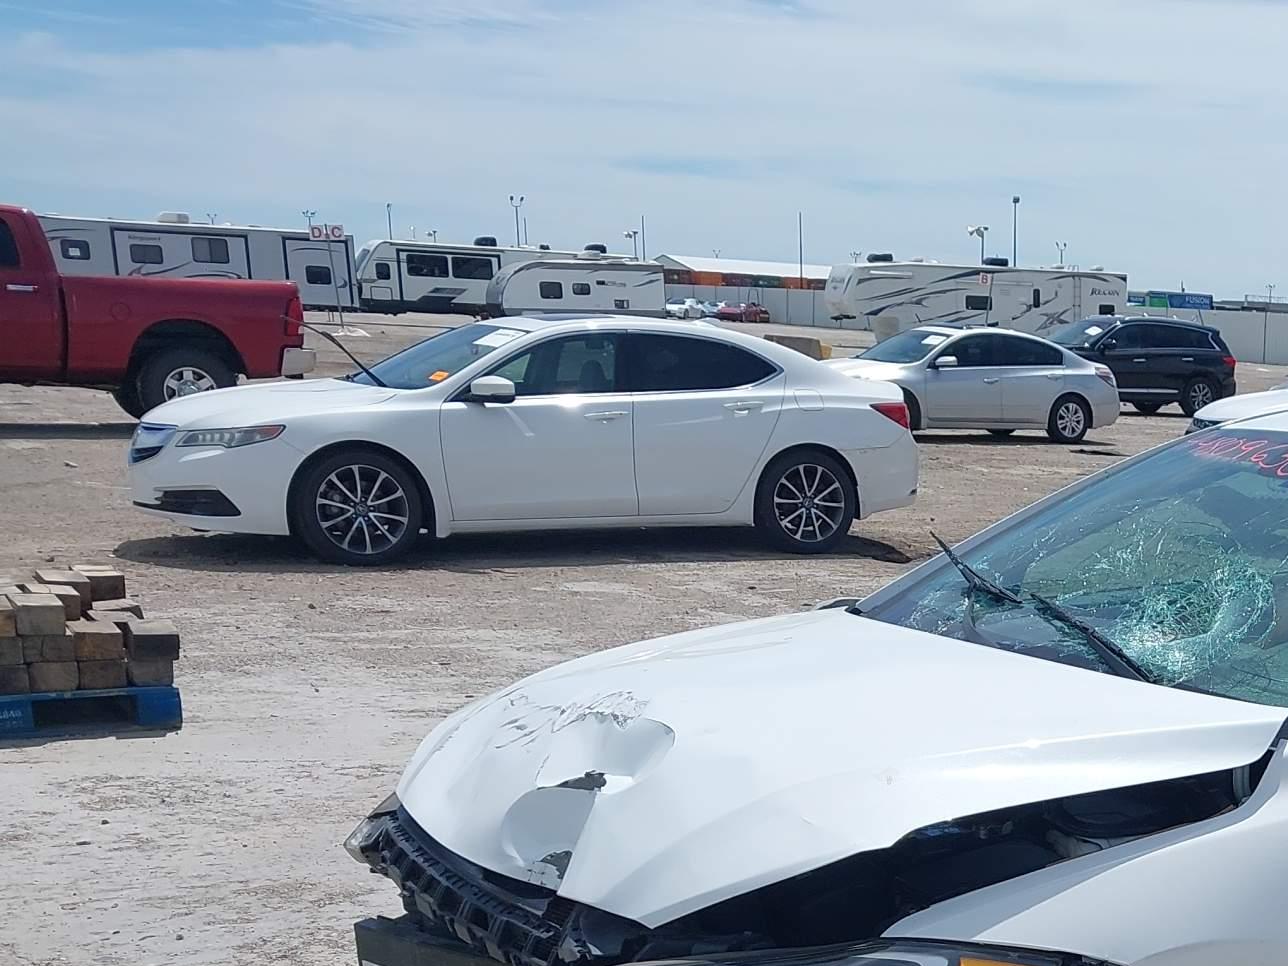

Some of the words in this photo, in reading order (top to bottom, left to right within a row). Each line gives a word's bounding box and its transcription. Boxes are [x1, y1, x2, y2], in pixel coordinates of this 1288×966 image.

[311, 226, 322, 239] D
[331, 226, 342, 239] C
[981, 274, 989, 284] B
